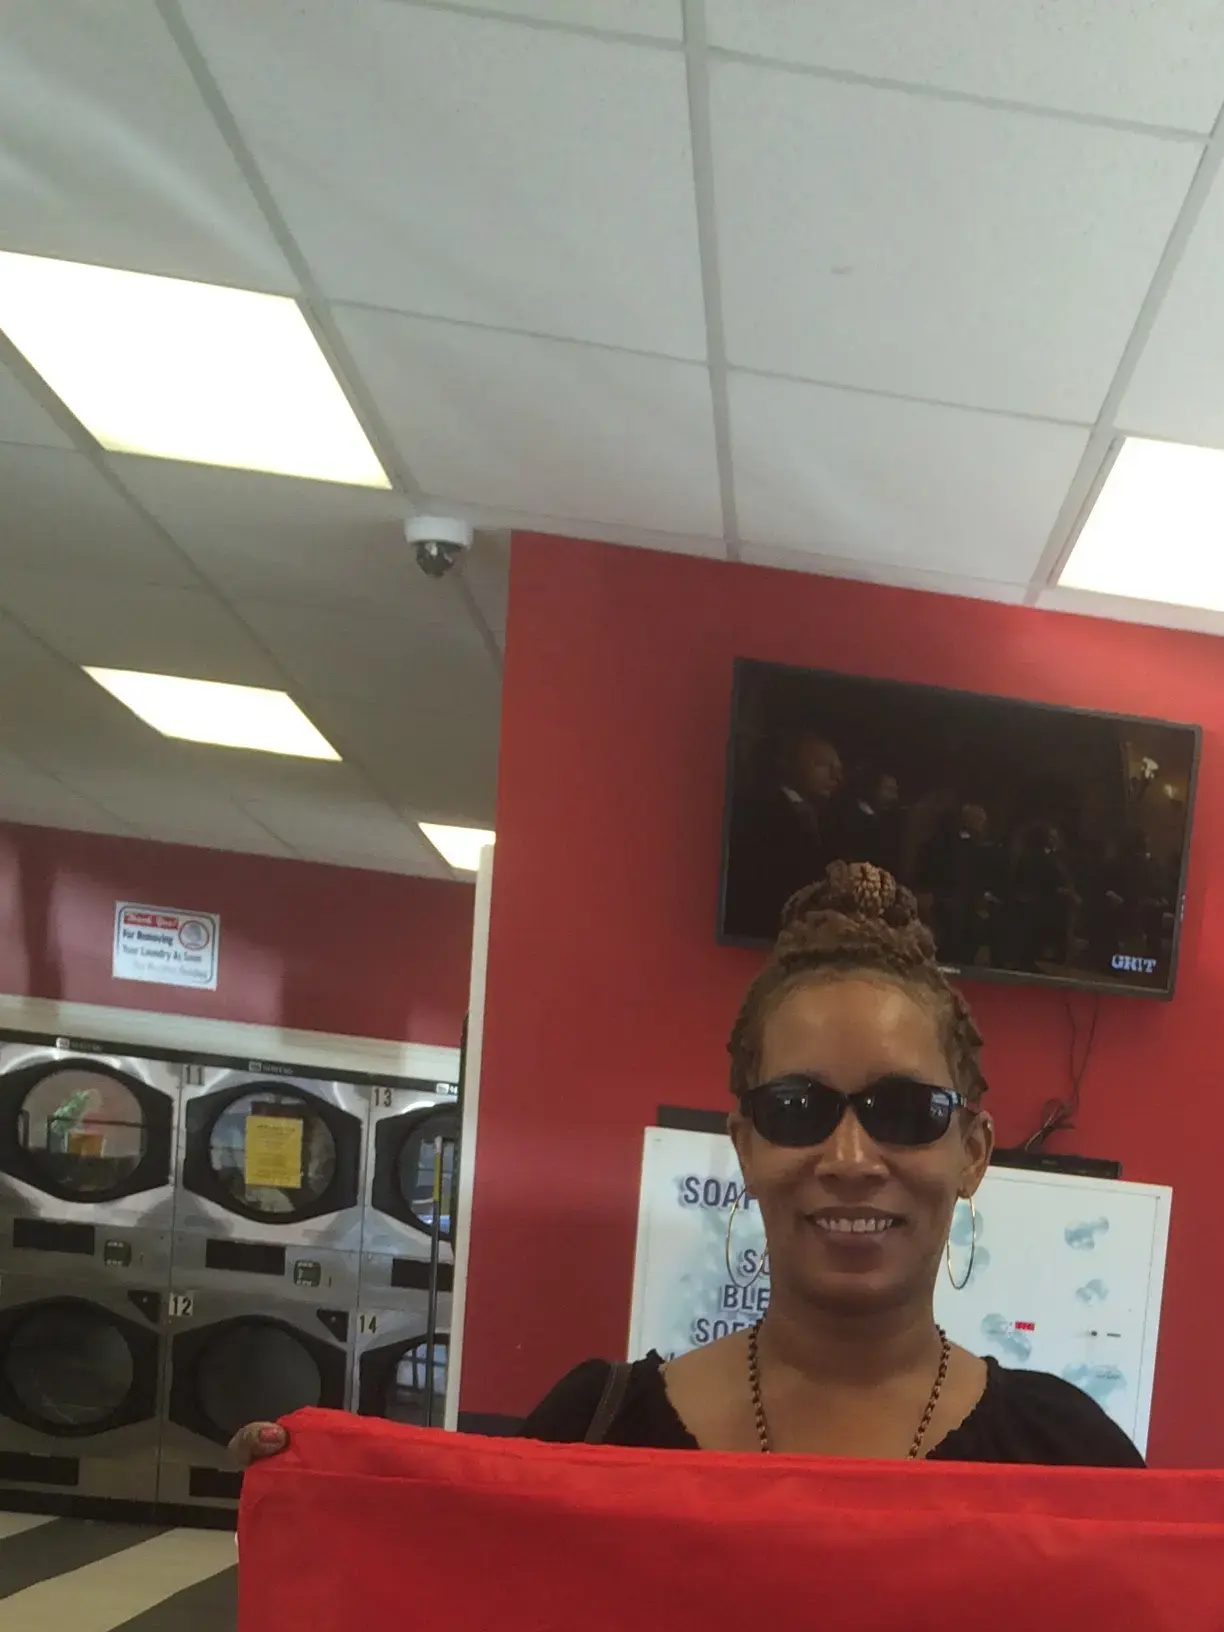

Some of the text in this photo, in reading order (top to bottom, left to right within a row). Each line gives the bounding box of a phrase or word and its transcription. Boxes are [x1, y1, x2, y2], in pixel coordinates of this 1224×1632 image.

[136, 931, 174, 947] Removing
[185, 1063, 205, 1086] 11
[374, 1087, 393, 1107] 13
[171, 1296, 191, 1316] 12
[358, 1315, 378, 1335] 14
